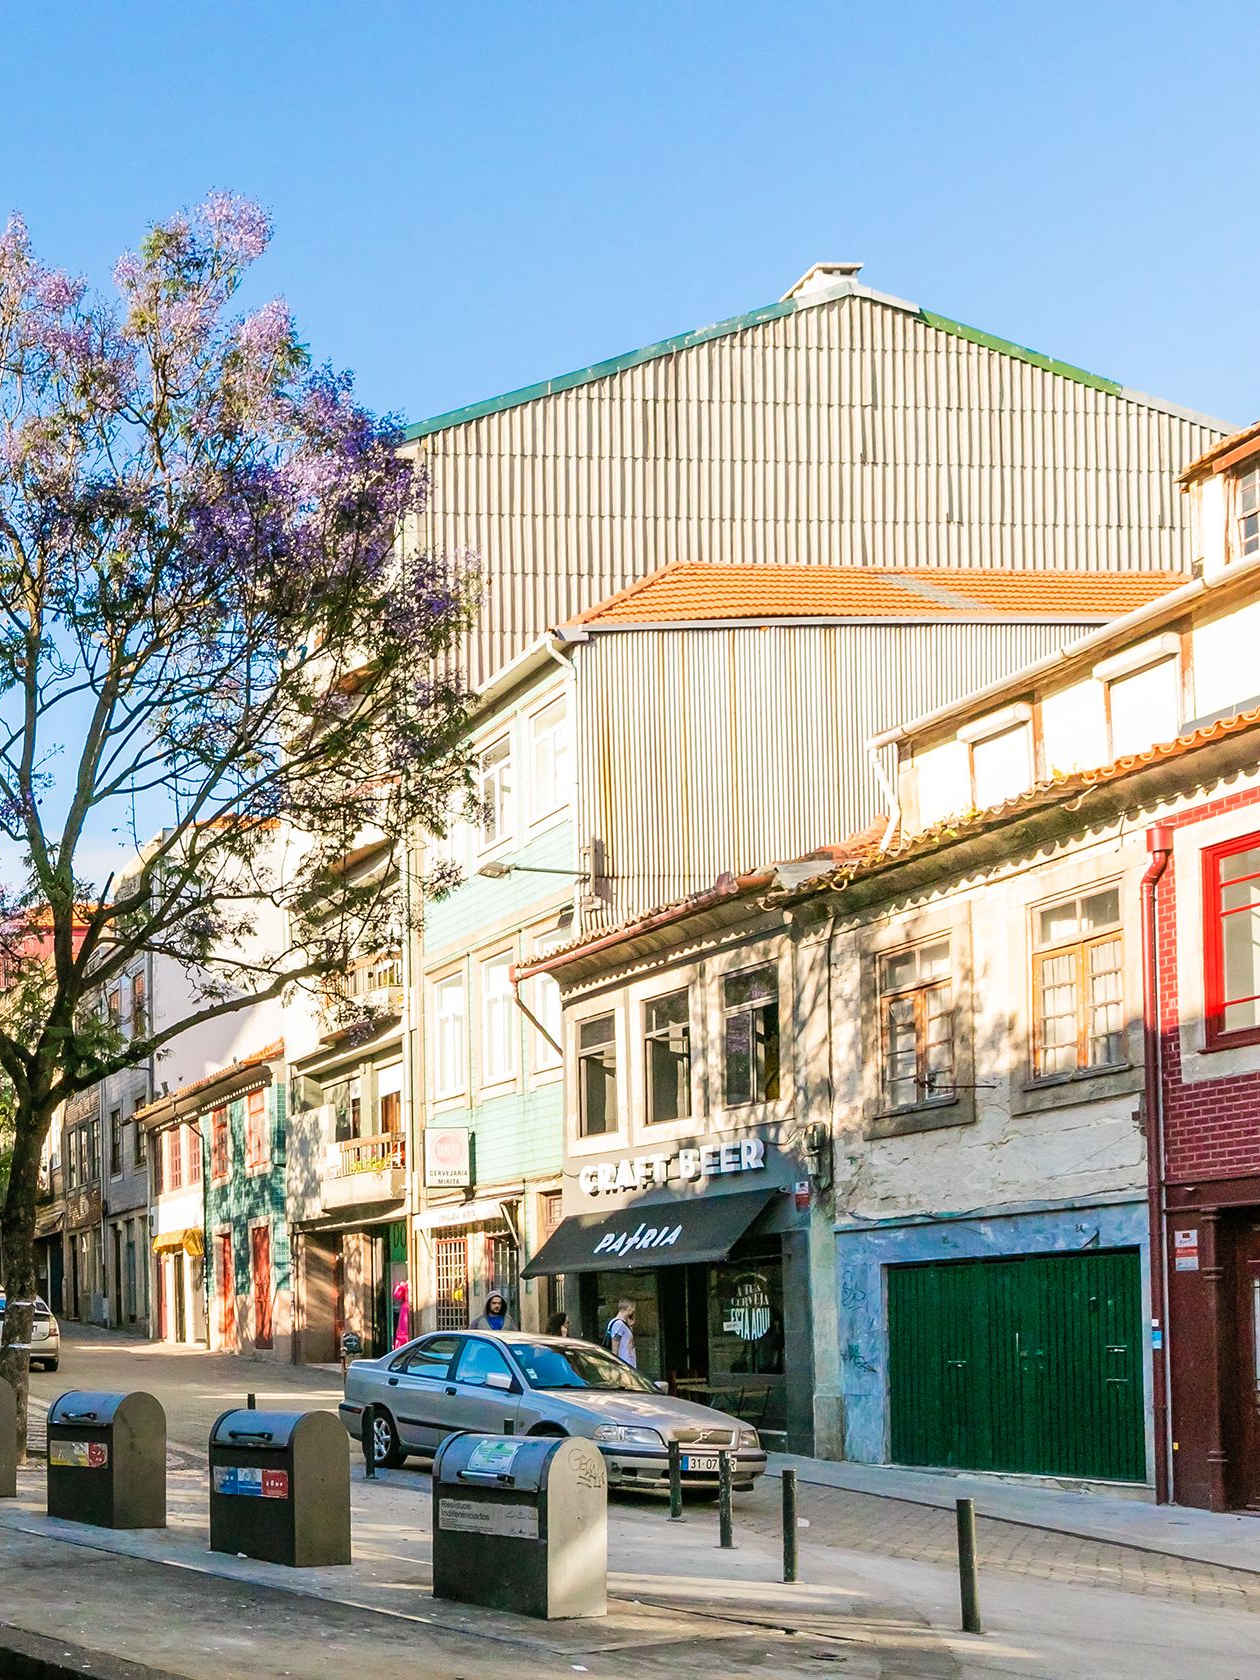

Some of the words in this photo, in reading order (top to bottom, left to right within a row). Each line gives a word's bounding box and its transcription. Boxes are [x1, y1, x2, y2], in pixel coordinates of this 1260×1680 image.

[429, 1169, 468, 1177] CERVEJARIA
[580, 1153, 670, 1196] CRAFT
[679, 1138, 765, 1180] BEER
